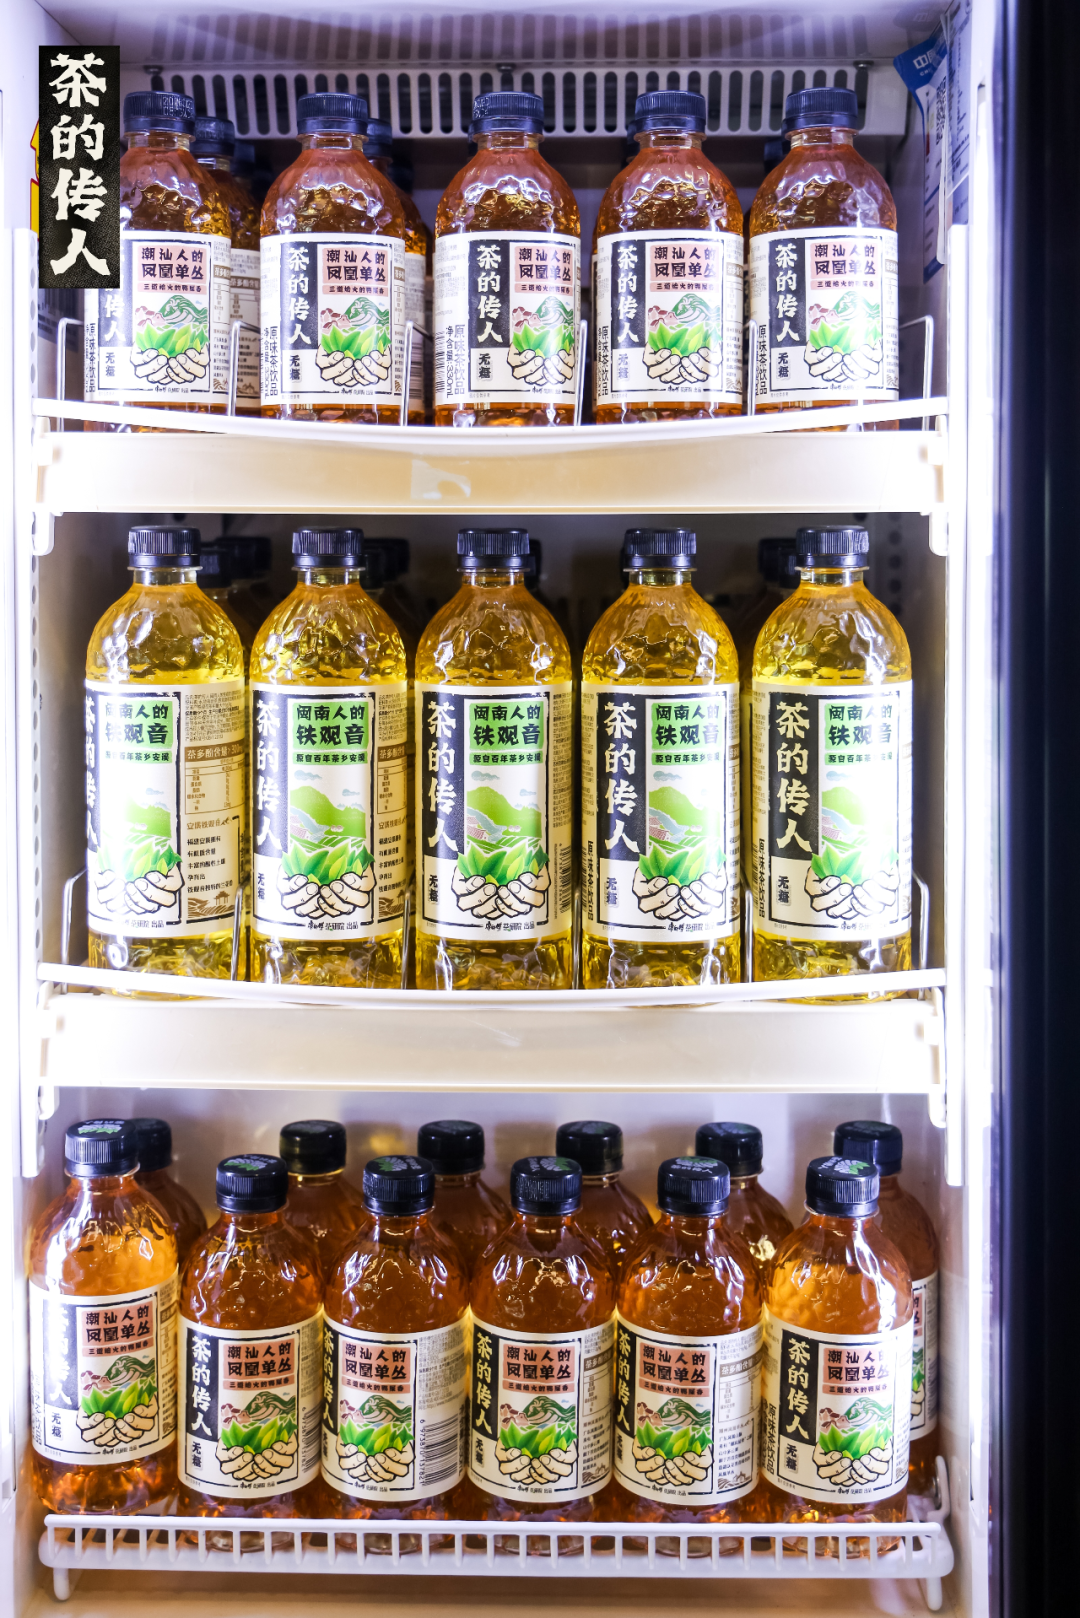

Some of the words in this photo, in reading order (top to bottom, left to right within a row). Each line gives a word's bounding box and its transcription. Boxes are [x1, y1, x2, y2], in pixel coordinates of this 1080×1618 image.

[142, 248, 203, 263] 潮汕人的
[327, 250, 386, 265] 潮汕人的
[519, 248, 571, 265] 潮汕人的
[654, 247, 716, 260] 潮汕人的
[814, 245, 875, 258] 潮汕人的
[142, 264, 204, 280] 凤凰单丛
[327, 266, 386, 282] 凤凰单丛
[519, 264, 571, 282] 凤凰单丛
[654, 262, 717, 278] 凤凰单丛
[815, 260, 876, 275] 凤凰单丛
[288, 247, 312, 345] 茶的传人
[477, 244, 504, 343] 茶的传人
[617, 245, 640, 343] 茶的传人
[775, 243, 801, 342] 茶的传人
[289, 355, 301, 381] 无糖
[454, 324, 466, 395] 原味茶饮品
[478, 353, 491, 379] 无糖
[778, 352, 790, 378] 无糖
[105, 703, 168, 721] 闽南人的
[297, 704, 365, 721] 闽南人的
[473, 704, 540, 720] 闽南人的
[655, 704, 719, 720] 闽南人的
[828, 704, 893, 721] 闽南人的
[296, 723, 366, 746] 铁观音
[473, 723, 540, 746] 铁观音
[655, 723, 719, 746] 铁观音
[828, 722, 893, 746] 铁观音
[256, 700, 283, 851] 茶的传人
[427, 700, 460, 852] 茶的传人
[604, 701, 640, 854] 茶的传人
[776, 701, 813, 853] 茶的传人
[87, 1305, 150, 1326] 潮汕人的
[87, 1320, 151, 1343] 凤凰单丛
[228, 1342, 292, 1360] 潮汕人的
[345, 1343, 406, 1363] 潮汕人的
[506, 1346, 571, 1362] 潮汕人的
[643, 1345, 706, 1366] 潮汕人的
[228, 1356, 292, 1378] 凤凰单丛
[345, 1359, 407, 1381] 凤凰单丛
[506, 1361, 571, 1380] 凤凰单丛
[643, 1361, 706, 1384] 凤凰单丛
[828, 1364, 889, 1382] 凤凰单丛
[192, 1336, 213, 1438] 茶的传人
[475, 1333, 493, 1435] 茶的传人
[785, 1338, 811, 1440] 茶的传人
[785, 1443, 797, 1471] 无糖
